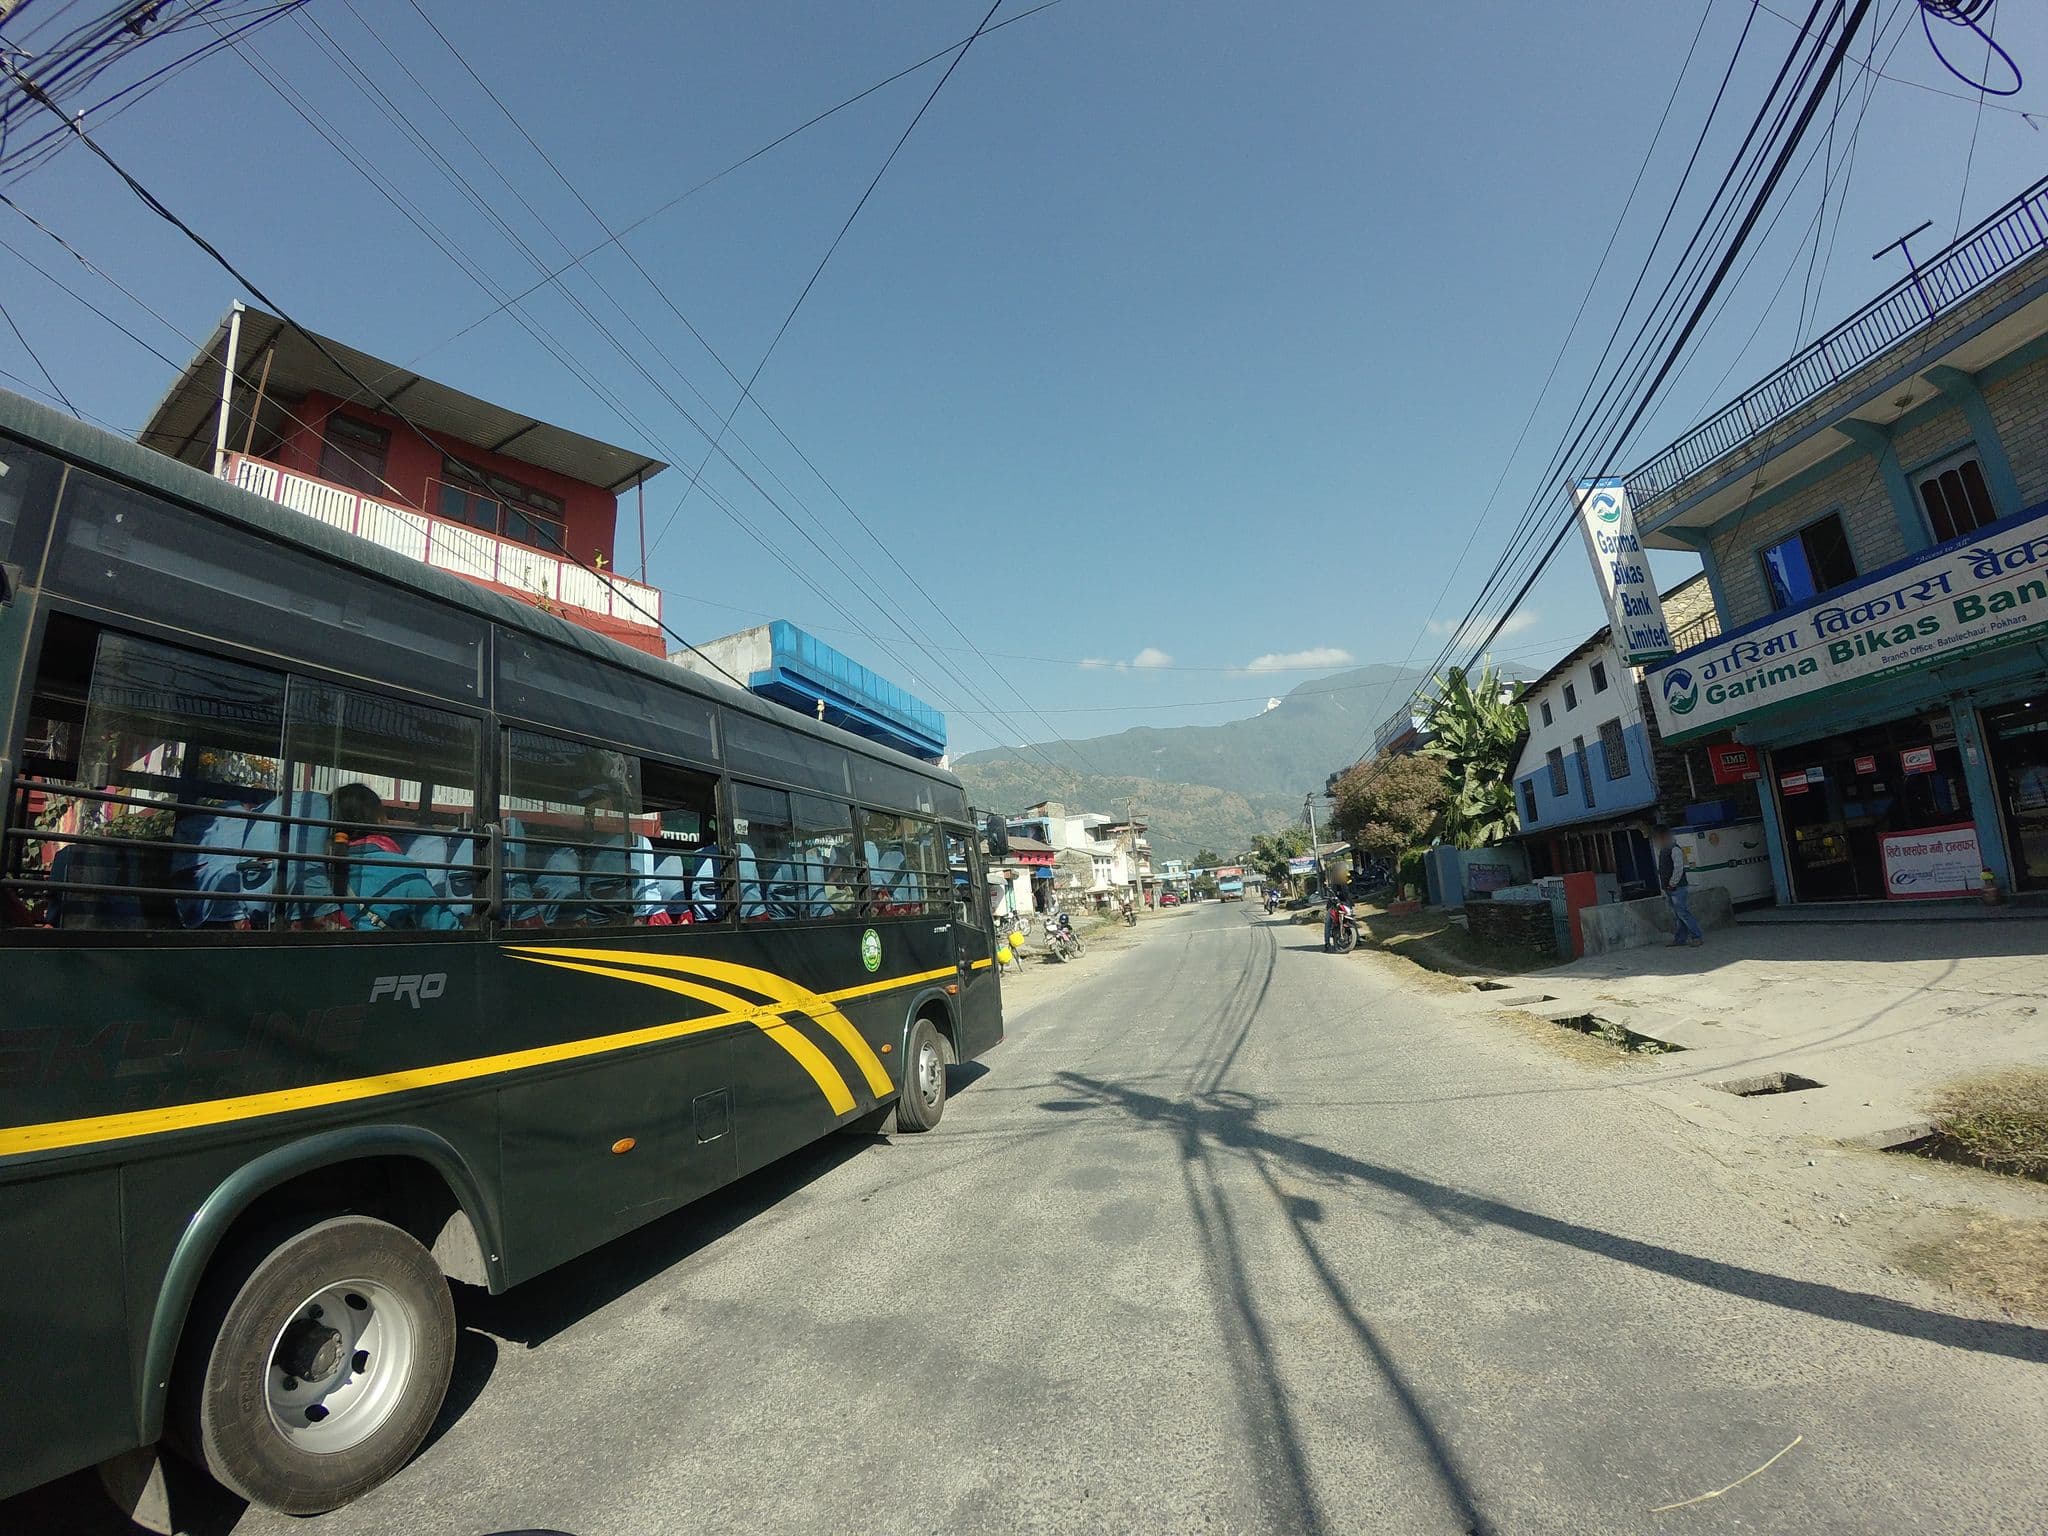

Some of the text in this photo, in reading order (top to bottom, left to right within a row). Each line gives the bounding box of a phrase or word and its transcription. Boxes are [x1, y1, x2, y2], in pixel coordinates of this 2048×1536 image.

[1597, 529, 1639, 555] Garima
[1610, 560, 1644, 585] Bikas
[1621, 591, 1653, 617] Bank
[1624, 622, 1669, 650] Limited
[1698, 630, 1797, 680] गरिमा
[1811, 571, 1952, 638] विकास
[1705, 656, 1818, 705] Garima
[1828, 615, 1940, 665] Bikas
[1953, 570, 2048, 624] Ban
[1882, 650, 1909, 664] Branch
[1990, 614, 2028, 632] Pokhara
[368, 973, 448, 1009] PRO
